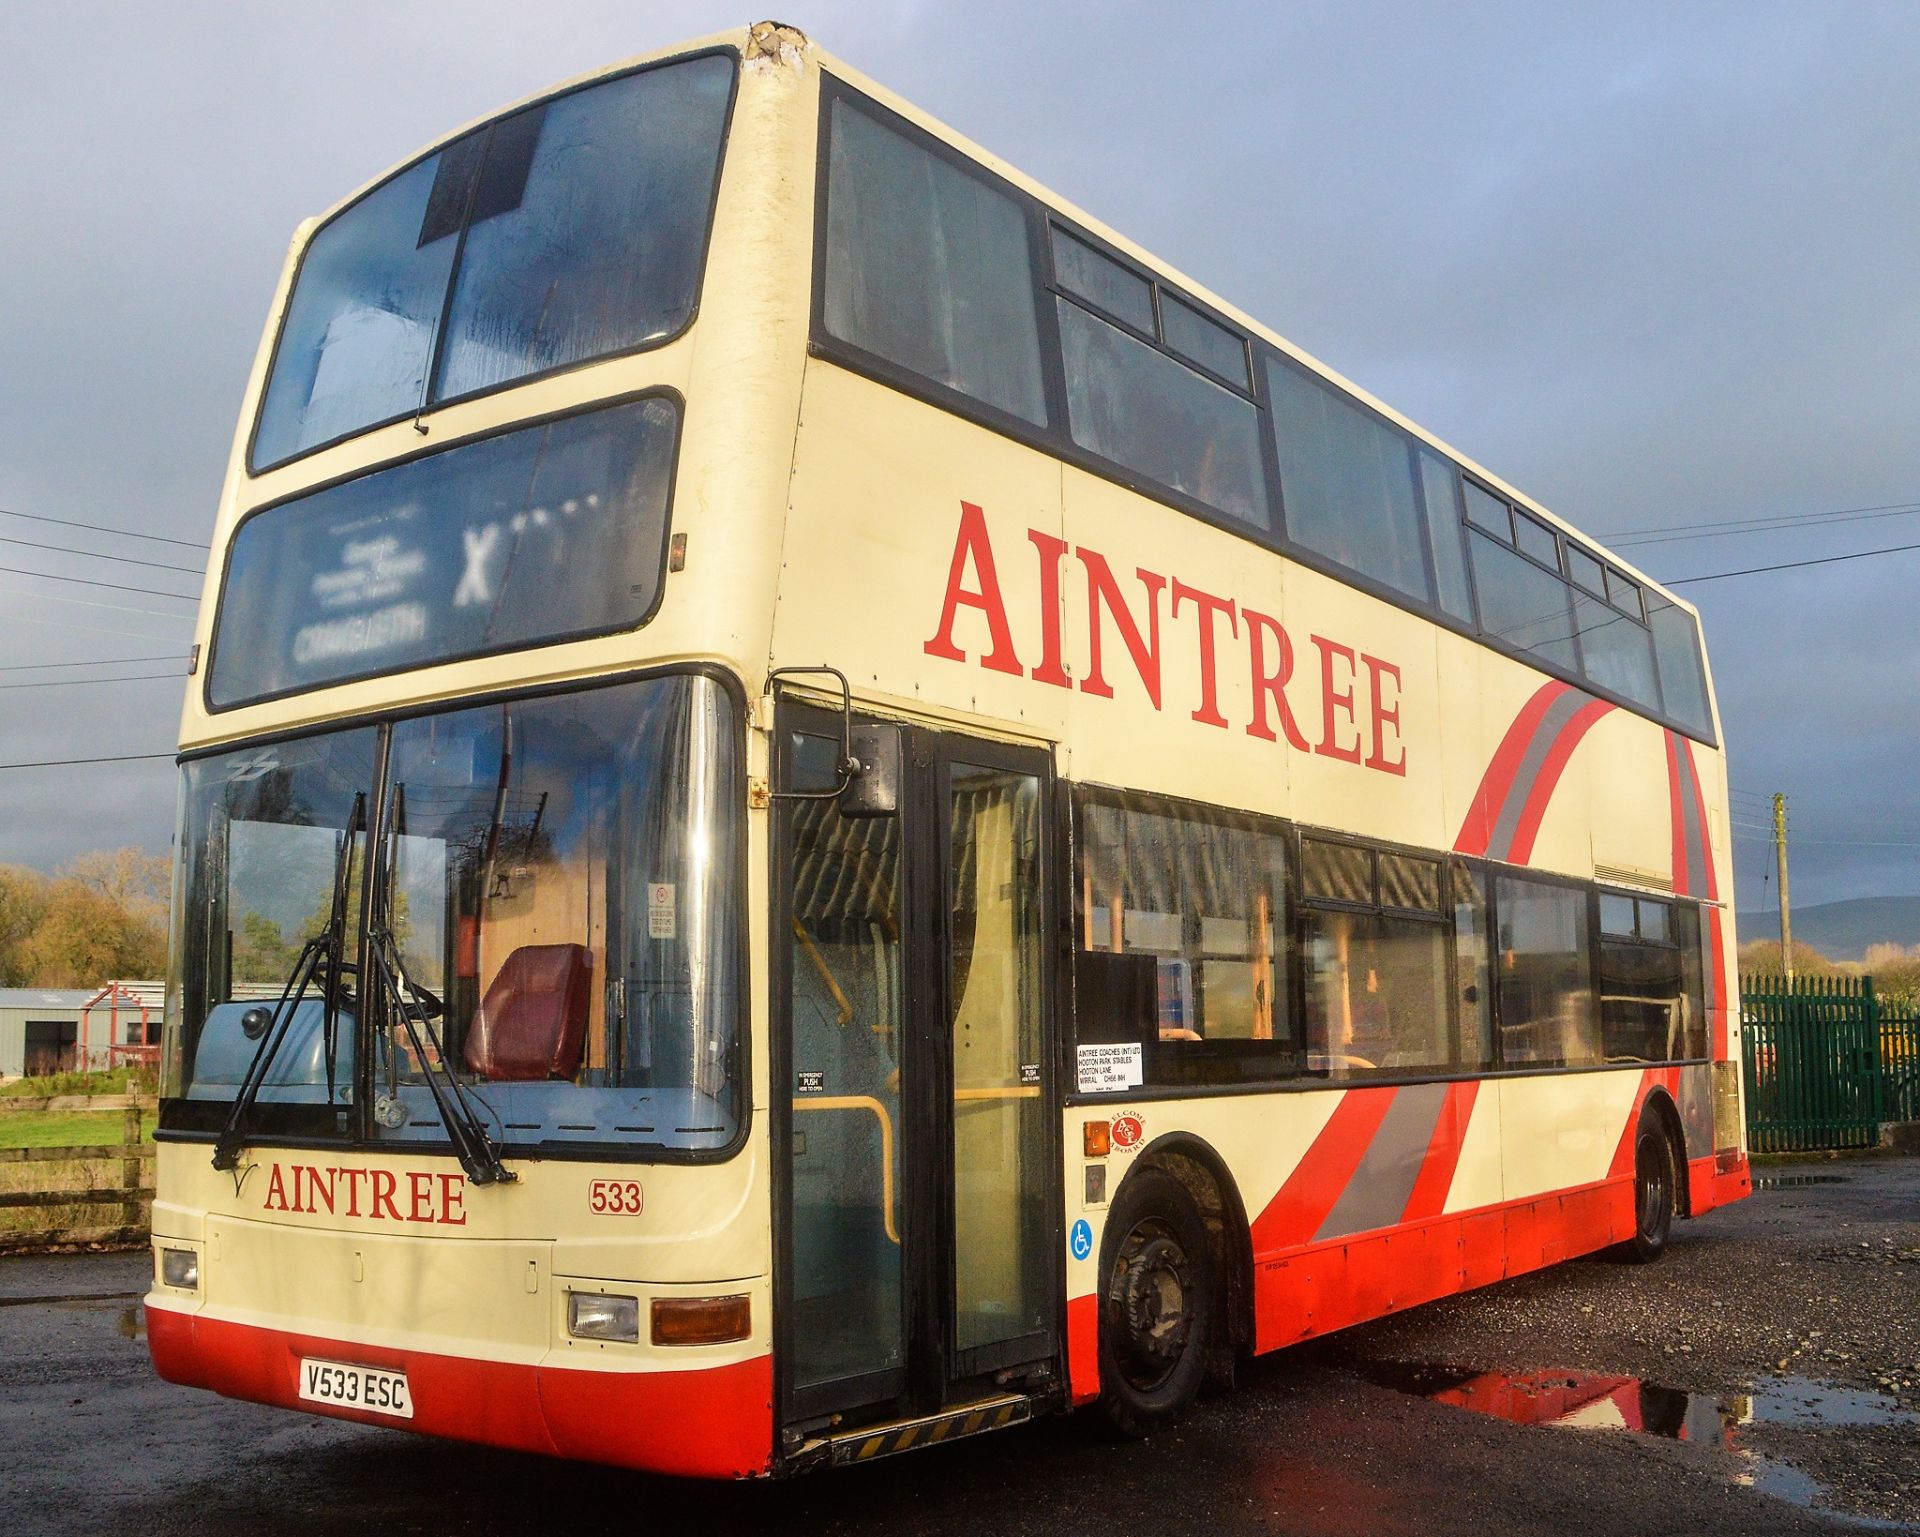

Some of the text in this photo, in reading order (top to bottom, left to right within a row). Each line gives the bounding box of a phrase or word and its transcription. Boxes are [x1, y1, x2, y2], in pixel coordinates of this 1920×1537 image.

[924, 500, 1406, 777] AINTREE
[1079, 1049, 1098, 1057] AINTREE
[1099, 1048, 1120, 1056] COACHES
[1113, 1056, 1132, 1064] STABLES
[1100, 1066, 1112, 1074] LANE
[803, 1078, 818, 1086] PUSH
[1080, 1076, 1098, 1084] WIRRAL
[263, 1163, 467, 1226] AINTREE
[592, 1182, 641, 1214] 533
[308, 1365, 405, 1409] V533 ESC
